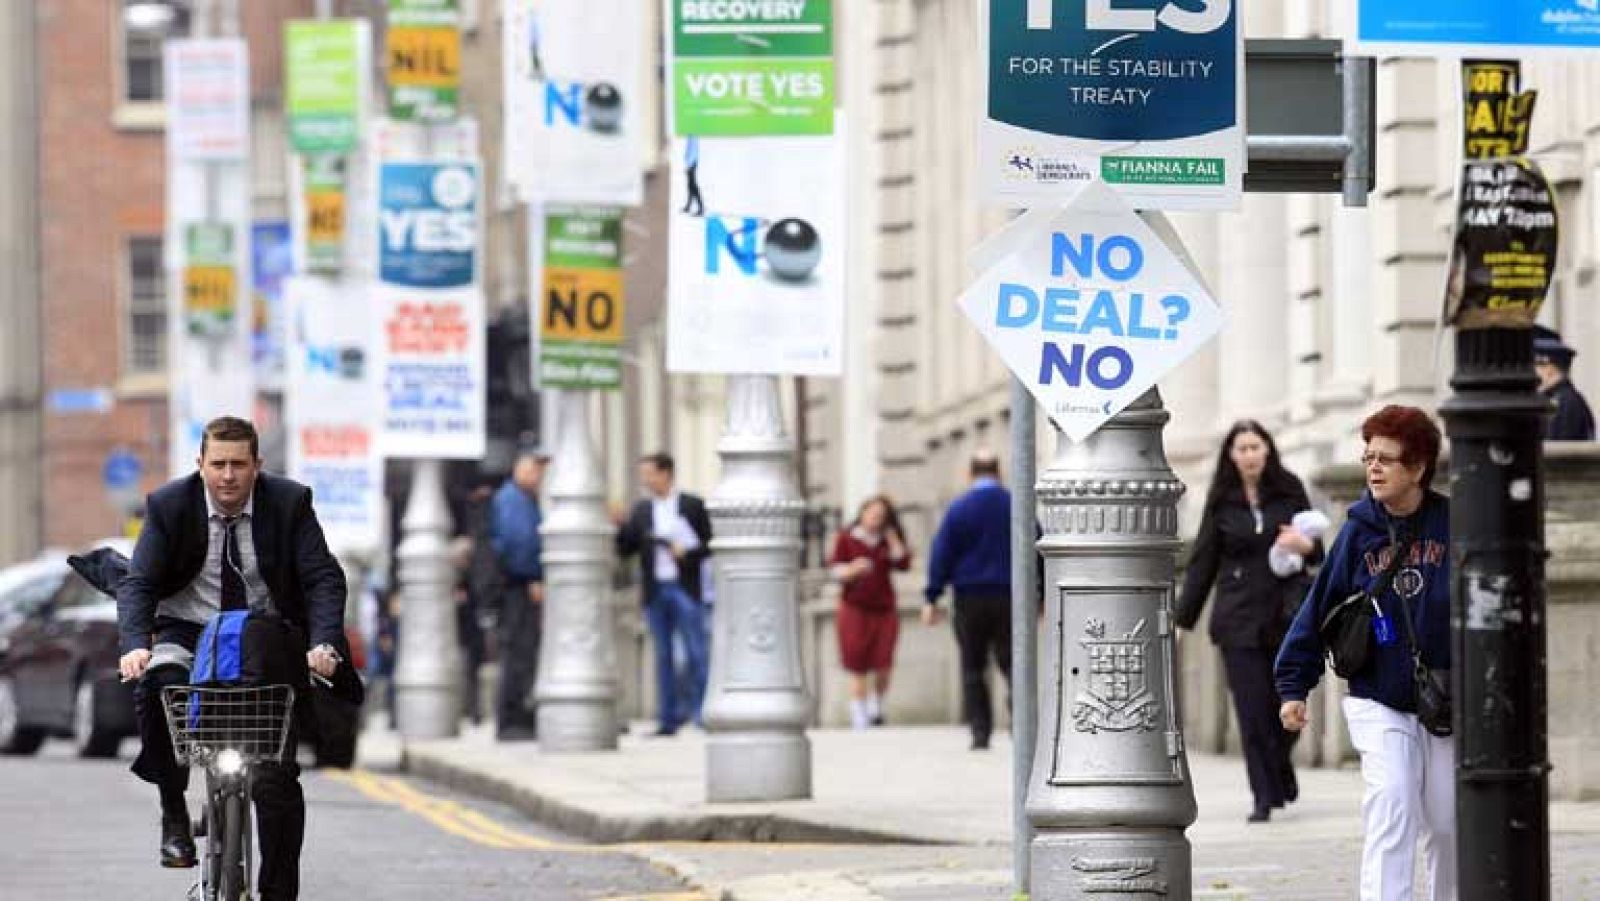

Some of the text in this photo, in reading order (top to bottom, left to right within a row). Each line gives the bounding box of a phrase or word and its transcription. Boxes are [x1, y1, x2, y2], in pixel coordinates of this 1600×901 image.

[681, 0, 807, 21] RECOVERY
[685, 71, 824, 99] VOTE YES
[1009, 57, 1214, 78] FOR THE STABILITY
[1070, 86, 1152, 105] TREATY
[379, 211, 476, 250] YES
[1050, 231, 1145, 281] NO
[546, 287, 614, 332] NO
[996, 283, 1191, 340] DEAL?
[1038, 342, 1134, 390] NO
